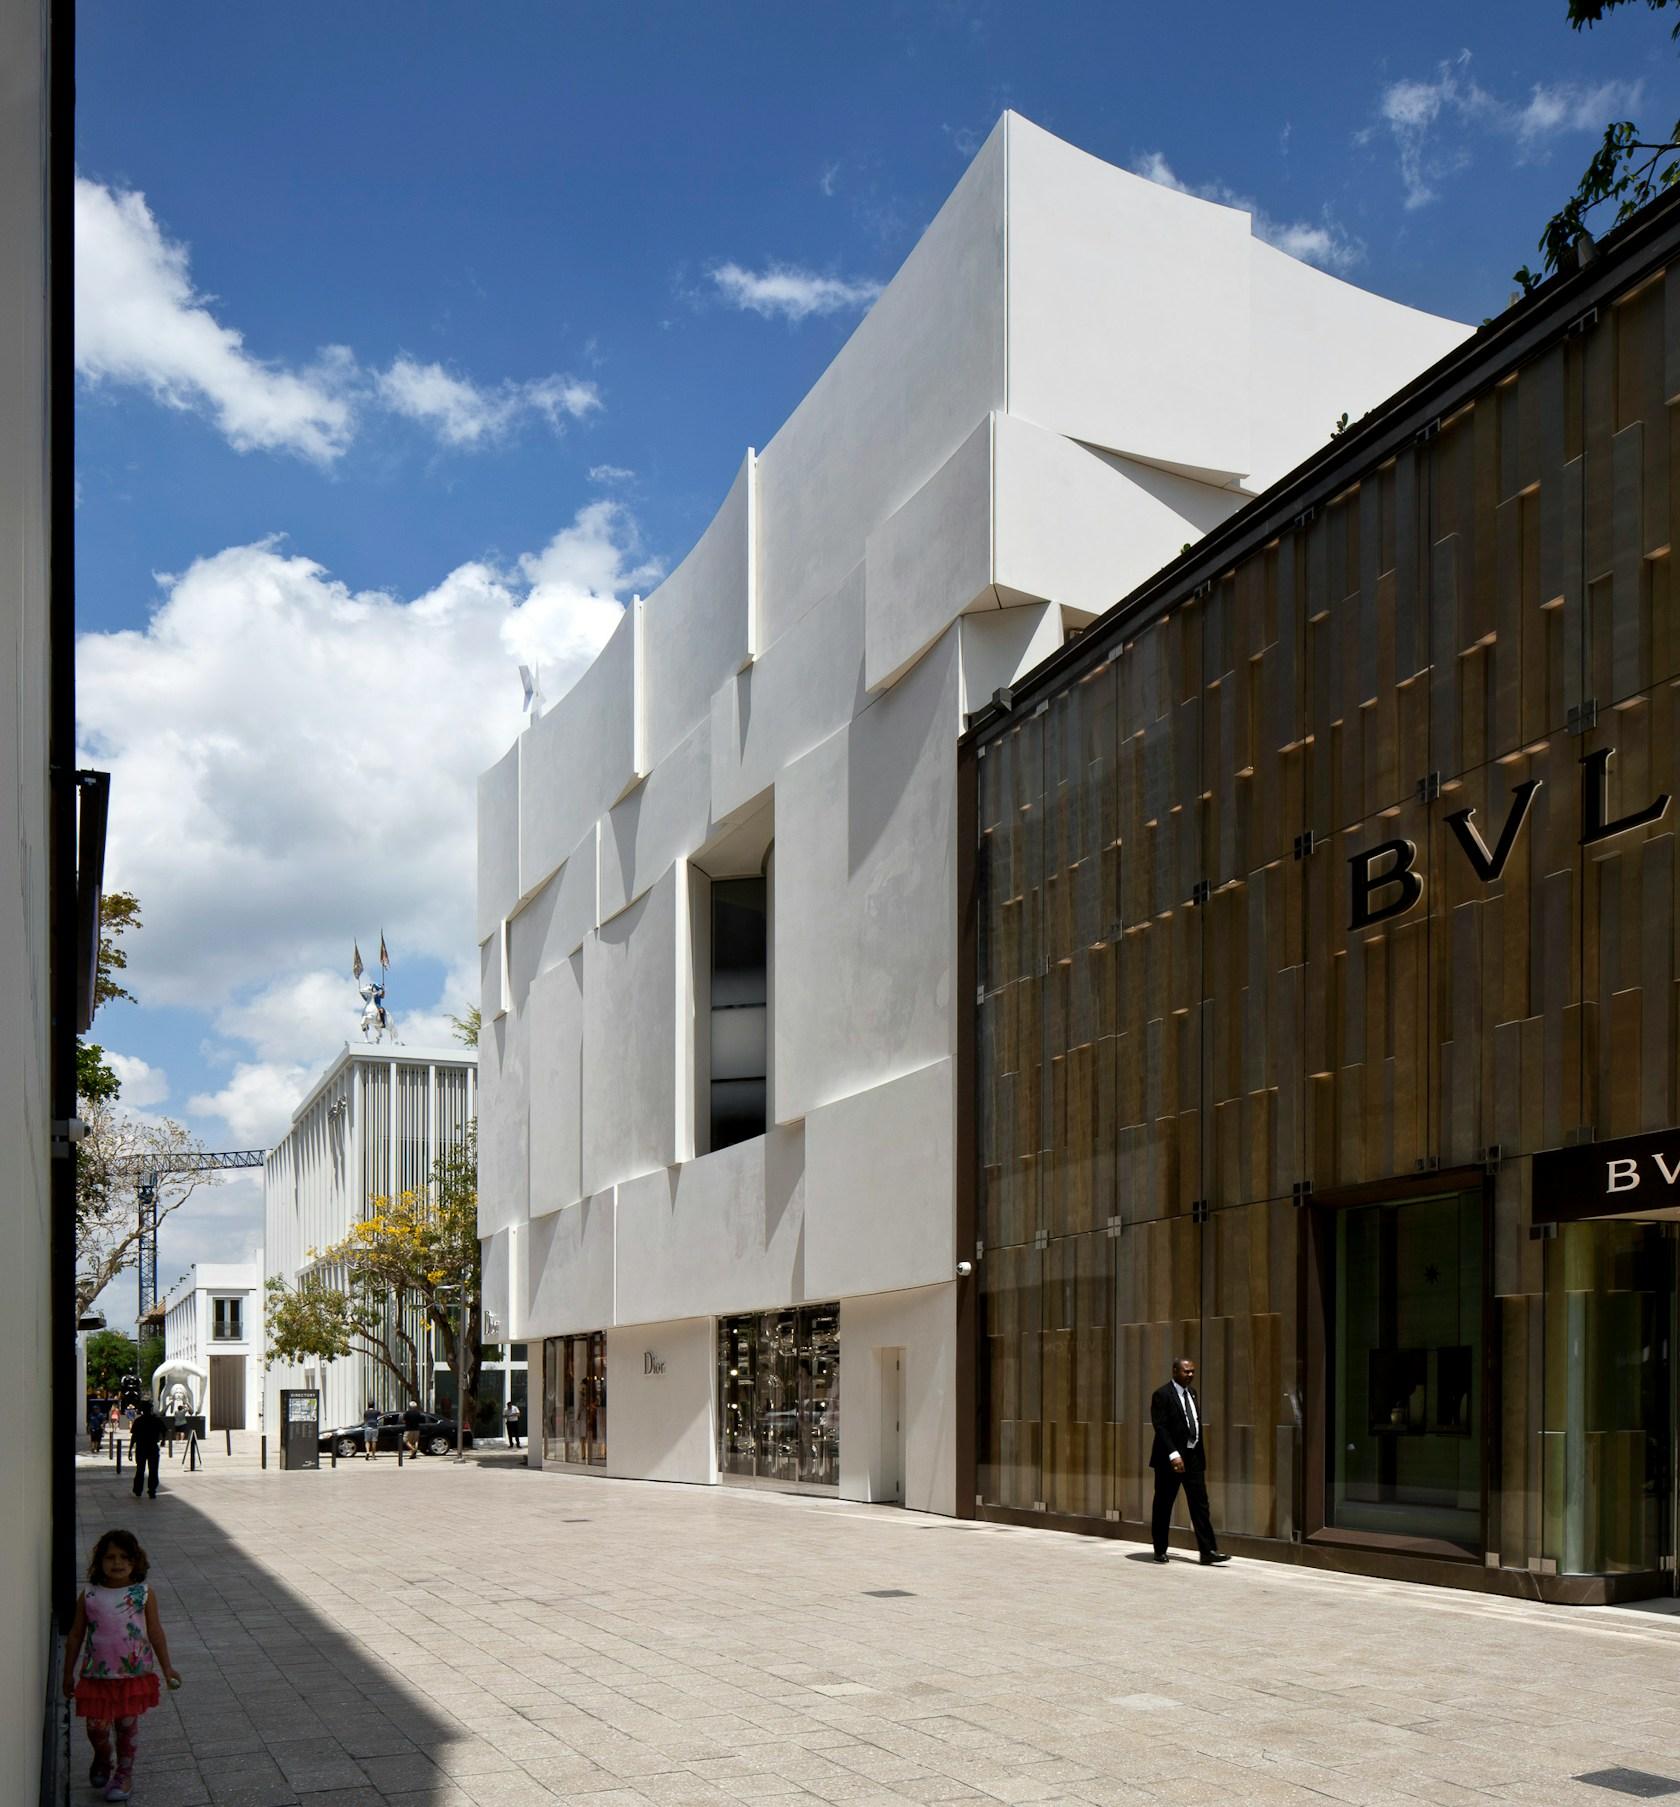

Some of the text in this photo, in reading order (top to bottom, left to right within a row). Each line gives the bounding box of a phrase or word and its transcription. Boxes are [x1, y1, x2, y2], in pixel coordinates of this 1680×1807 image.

[1347, 748, 1672, 932] BVL
[1605, 1153, 1680, 1194] BV
[644, 1351, 665, 1375] Dior
